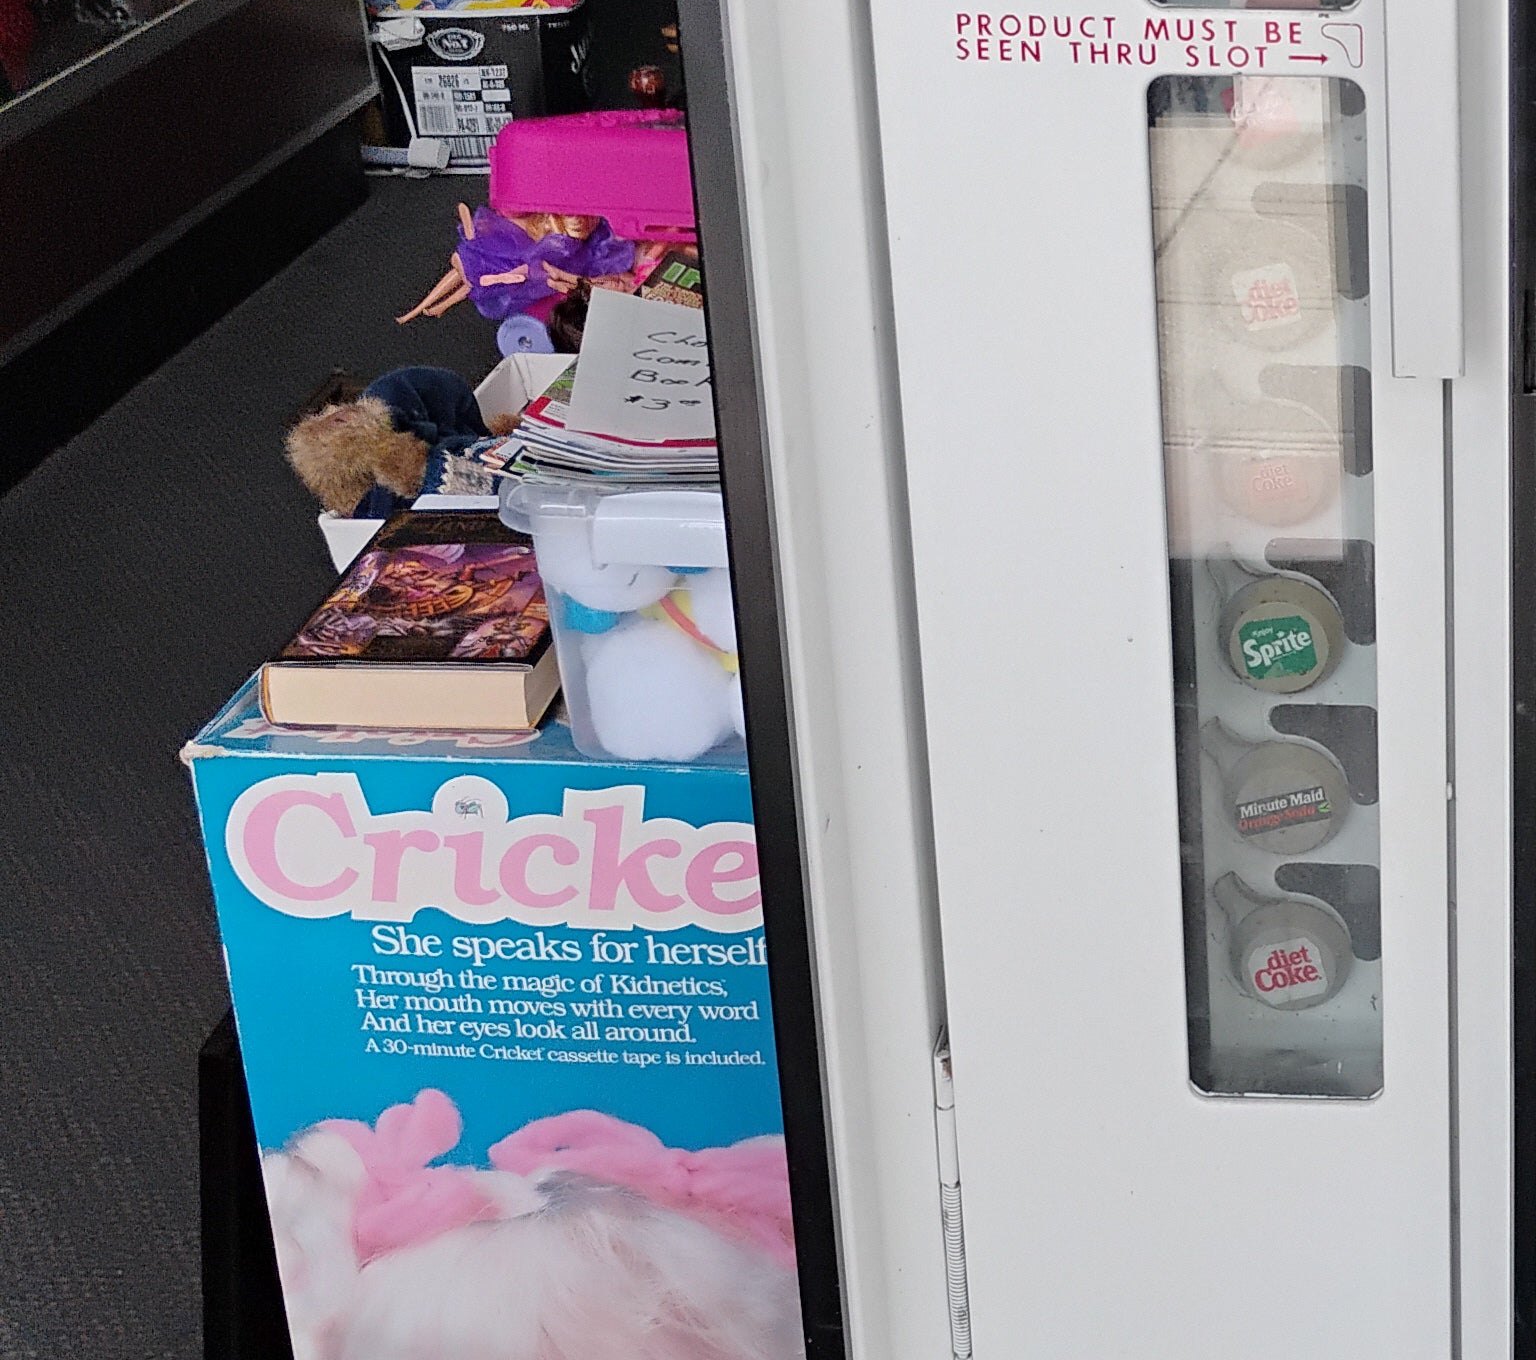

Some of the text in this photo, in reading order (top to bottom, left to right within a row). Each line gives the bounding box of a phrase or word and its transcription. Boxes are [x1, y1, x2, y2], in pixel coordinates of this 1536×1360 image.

[956, 13, 1302, 44] PRODUCT MUST BE
[956, 38, 1268, 68] SEEN THRU SLOT
[632, 348, 710, 367] Com
[1243, 630, 1312, 668] Sprite
[1239, 787, 1325, 819] Minute Maid
[371, 924, 768, 967] She speaks for herself
[1267, 945, 1312, 971] diet
[351, 964, 455, 994] Through
[458, 969, 498, 990] the
[502, 973, 576, 998] magic
[580, 973, 604, 994] of
[1254, 965, 1321, 992] Coke
[355, 988, 760, 1026] Her mouth moves with every word
[360, 1011, 698, 1044] And her eyes look all around.
[365, 1038, 767, 1069] A 30-minute Cricket cassette tape is included.
